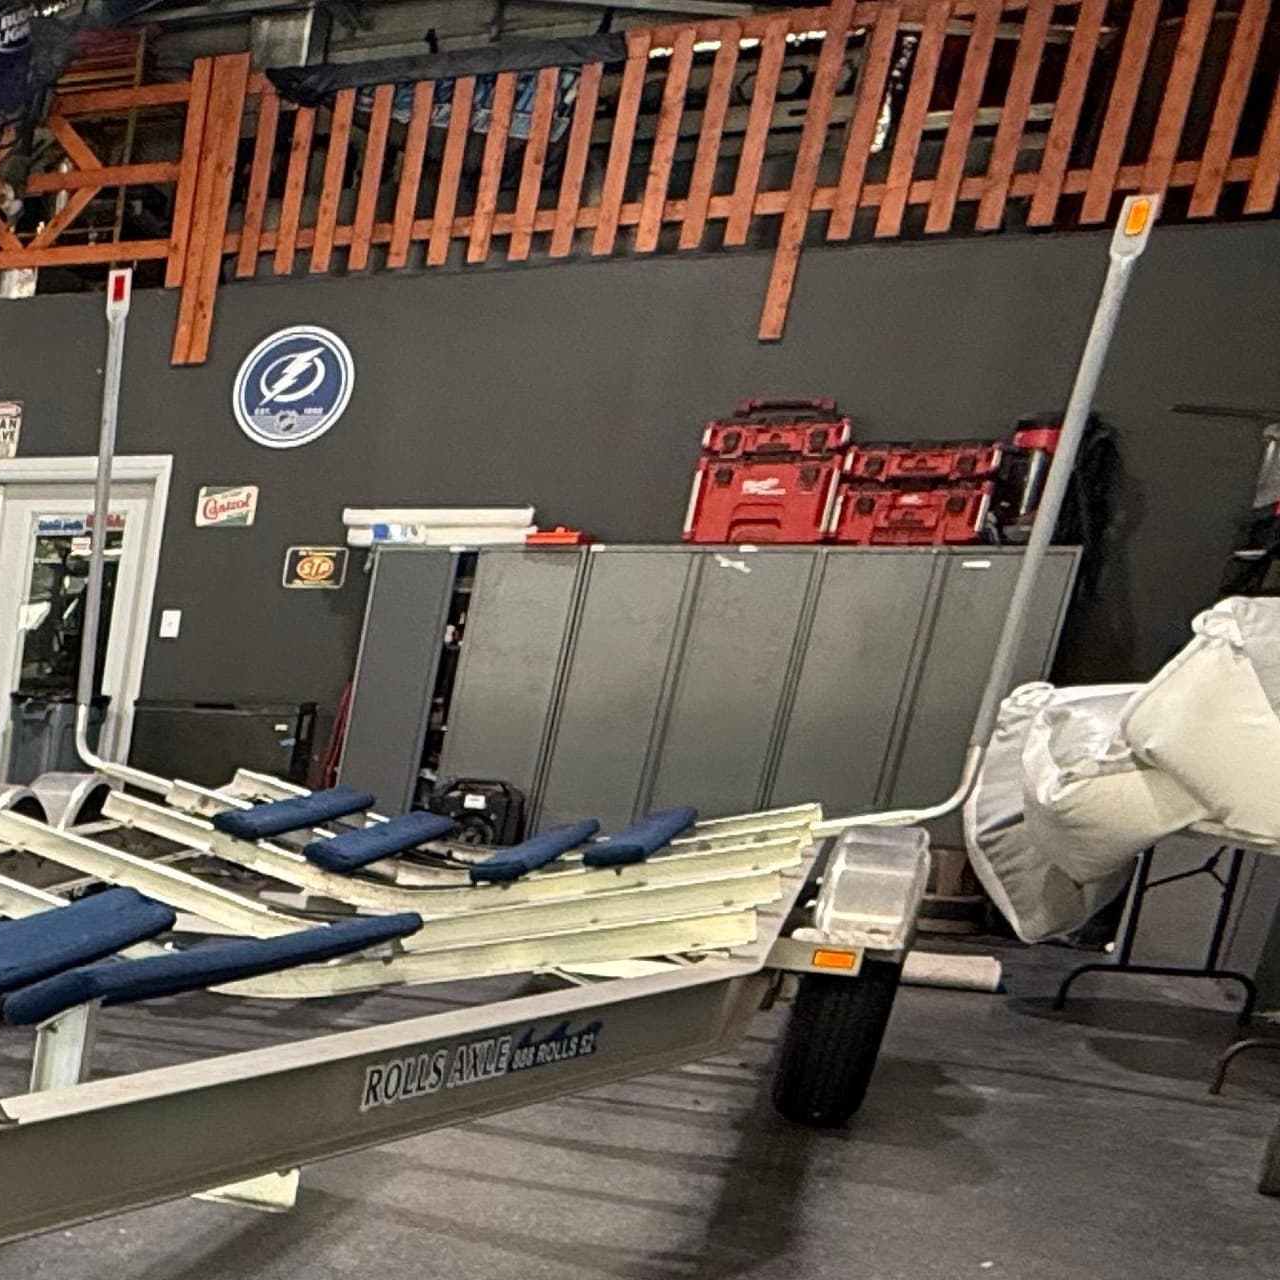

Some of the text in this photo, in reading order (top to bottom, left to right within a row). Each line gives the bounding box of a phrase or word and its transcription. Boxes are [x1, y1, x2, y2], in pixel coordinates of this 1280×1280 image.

[203, 493, 251, 520] Castrol
[301, 557, 331, 578] STP
[360, 1047, 449, 1113] ROLLS
[446, 1036, 512, 1089] AXLE
[536, 1036, 579, 1065] ROLLS
